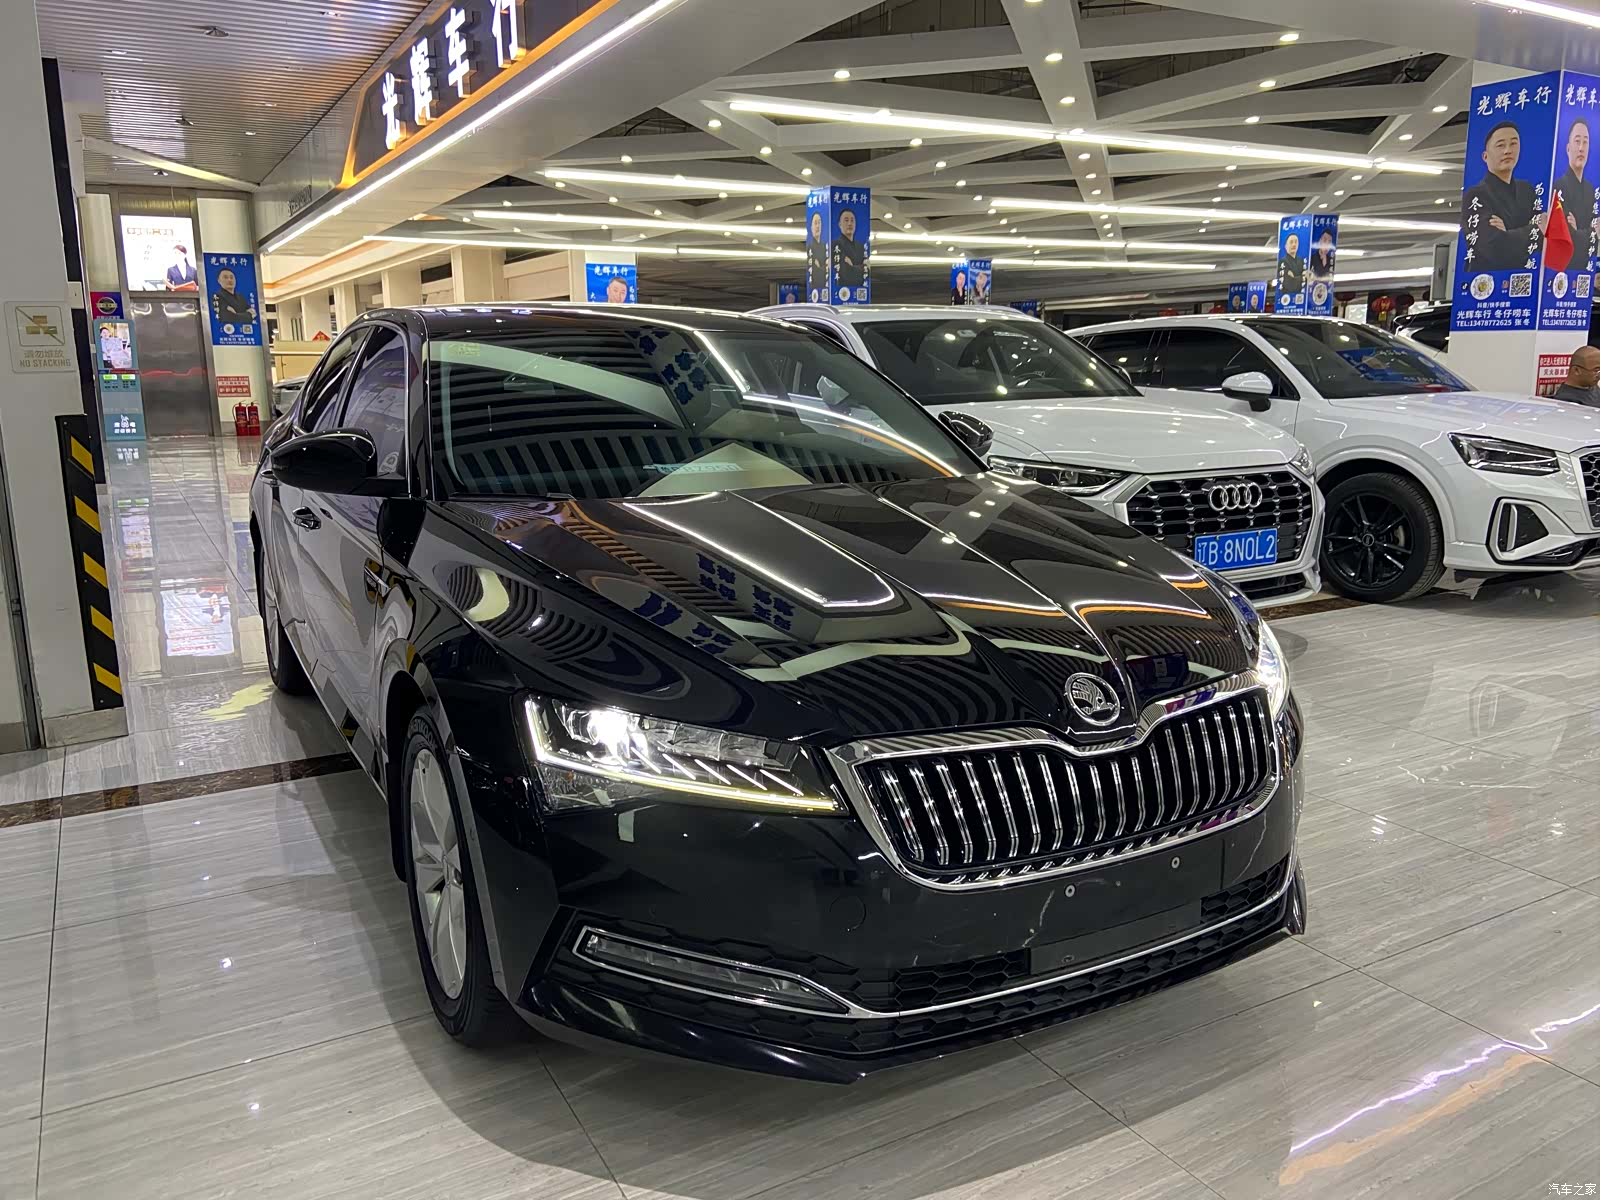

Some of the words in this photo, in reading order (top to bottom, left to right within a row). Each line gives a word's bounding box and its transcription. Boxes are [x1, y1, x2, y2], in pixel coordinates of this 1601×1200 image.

[382, 0, 520, 150] 光辉车行
[1477, 86, 1552, 115] 光辉车行
[1565, 84, 1599, 109] 光辉车
[834, 192, 868, 204] 光辉车行
[1283, 219, 1309, 230] 光辉车行
[1464, 197, 1483, 263] 冬仔唠车
[1524, 182, 1544, 269] 为您保驾护航
[211, 257, 247, 267] 光辉车行
[1457, 310, 1491, 319] 光辉车行
[1495, 309, 1531, 318] 冬仔唠车
[1543, 309, 1565, 318] 光辉车行
[33, 359, 71, 367] STACKING
